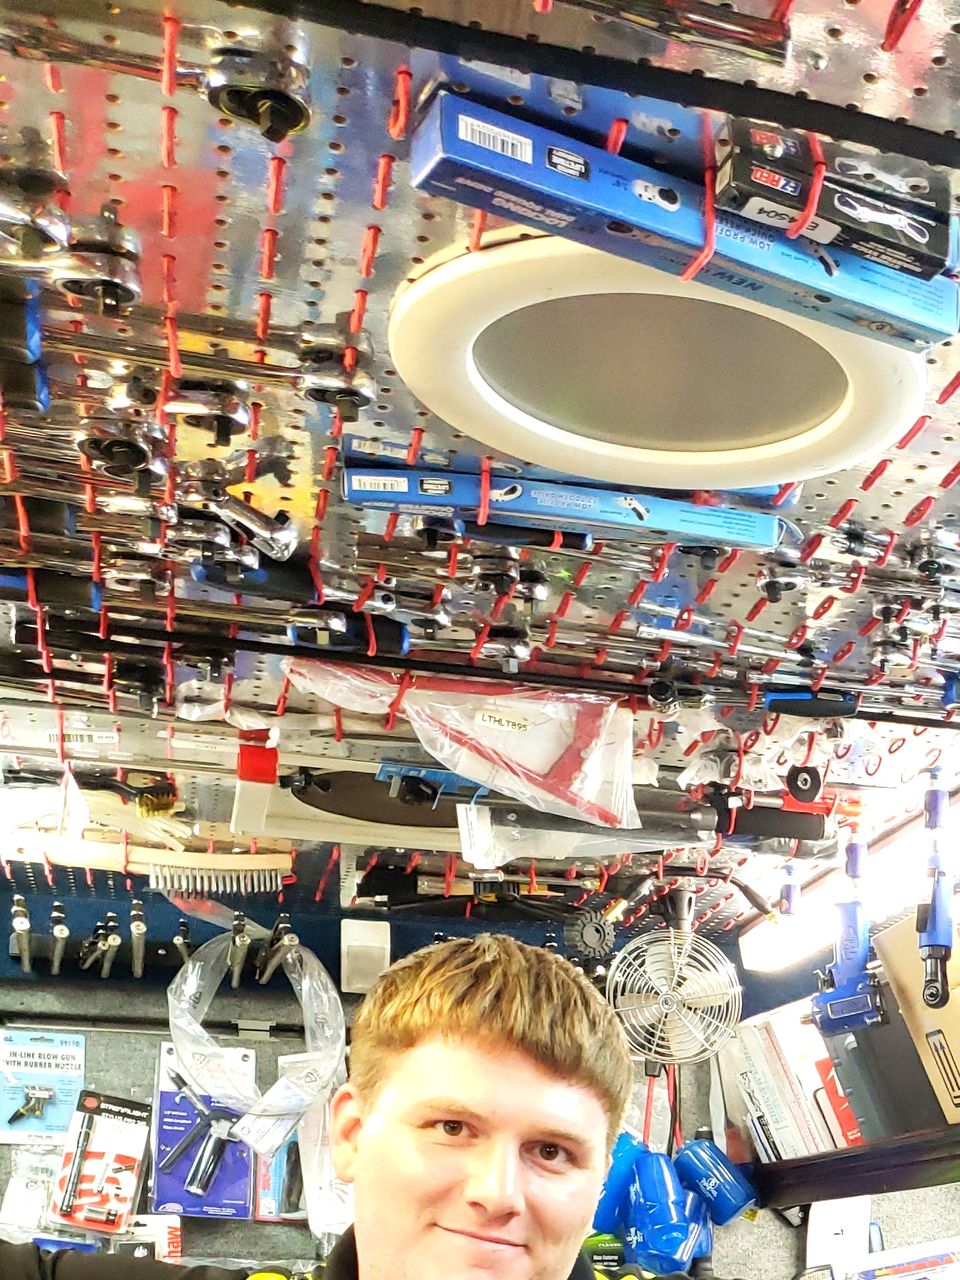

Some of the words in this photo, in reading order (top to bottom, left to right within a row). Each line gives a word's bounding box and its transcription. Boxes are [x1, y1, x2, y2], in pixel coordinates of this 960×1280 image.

[550, 155, 585, 172] LIFETIME
[491, 195, 568, 229] LOCKING
[757, 206, 819, 232] E4S04
[748, 236, 771, 251] LOW
[712, 269, 764, 293] NEW
[482, 713, 528, 732] LTHLT895
[10, 1051, 35, 1059] IN-LINE
[100, 1102, 149, 1118] STREAMLIGHT
[101, 1112, 124, 1122] STYLUS
